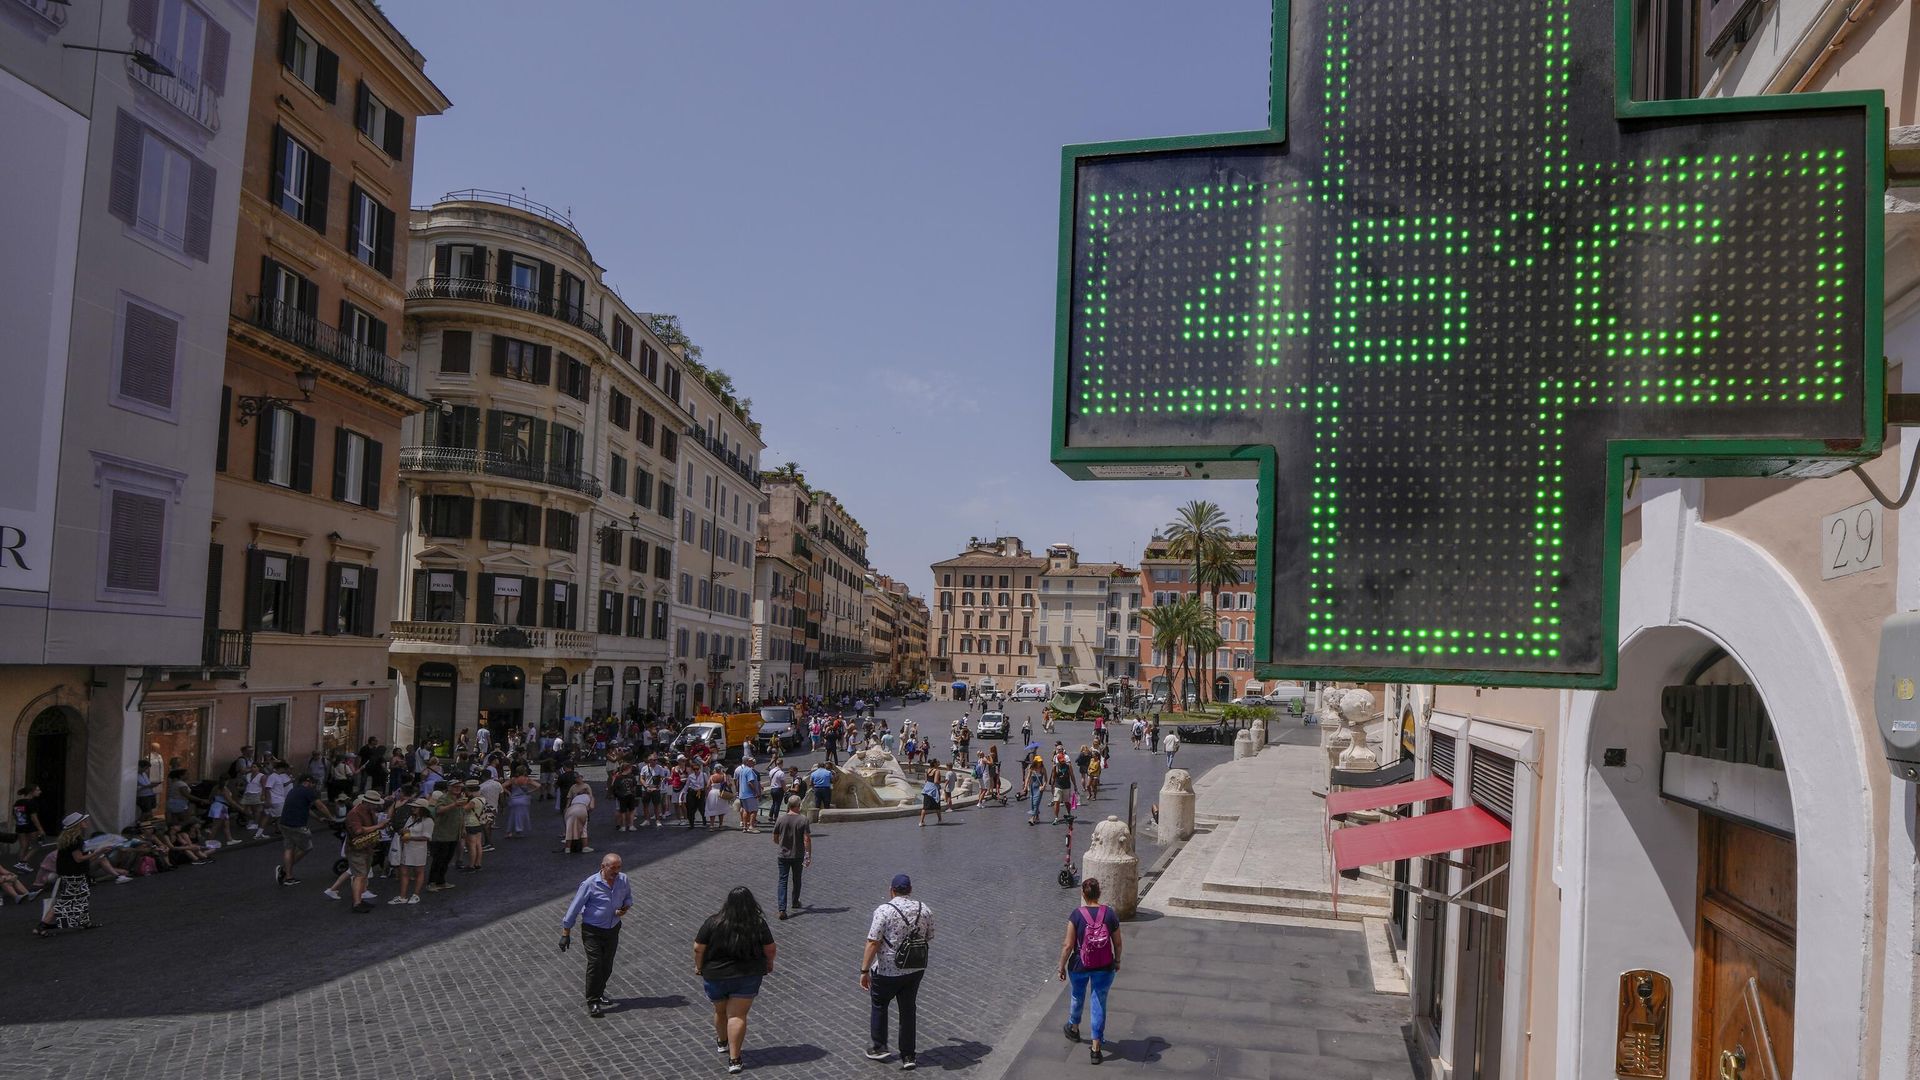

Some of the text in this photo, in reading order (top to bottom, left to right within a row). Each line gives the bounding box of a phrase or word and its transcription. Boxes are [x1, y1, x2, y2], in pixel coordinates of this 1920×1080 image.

[1830, 508, 1874, 569] 29
[0, 525, 32, 570] R
[267, 567, 281, 577] Dior
[341, 576, 354, 585] Dior
[160, 718, 186, 731] Dior
